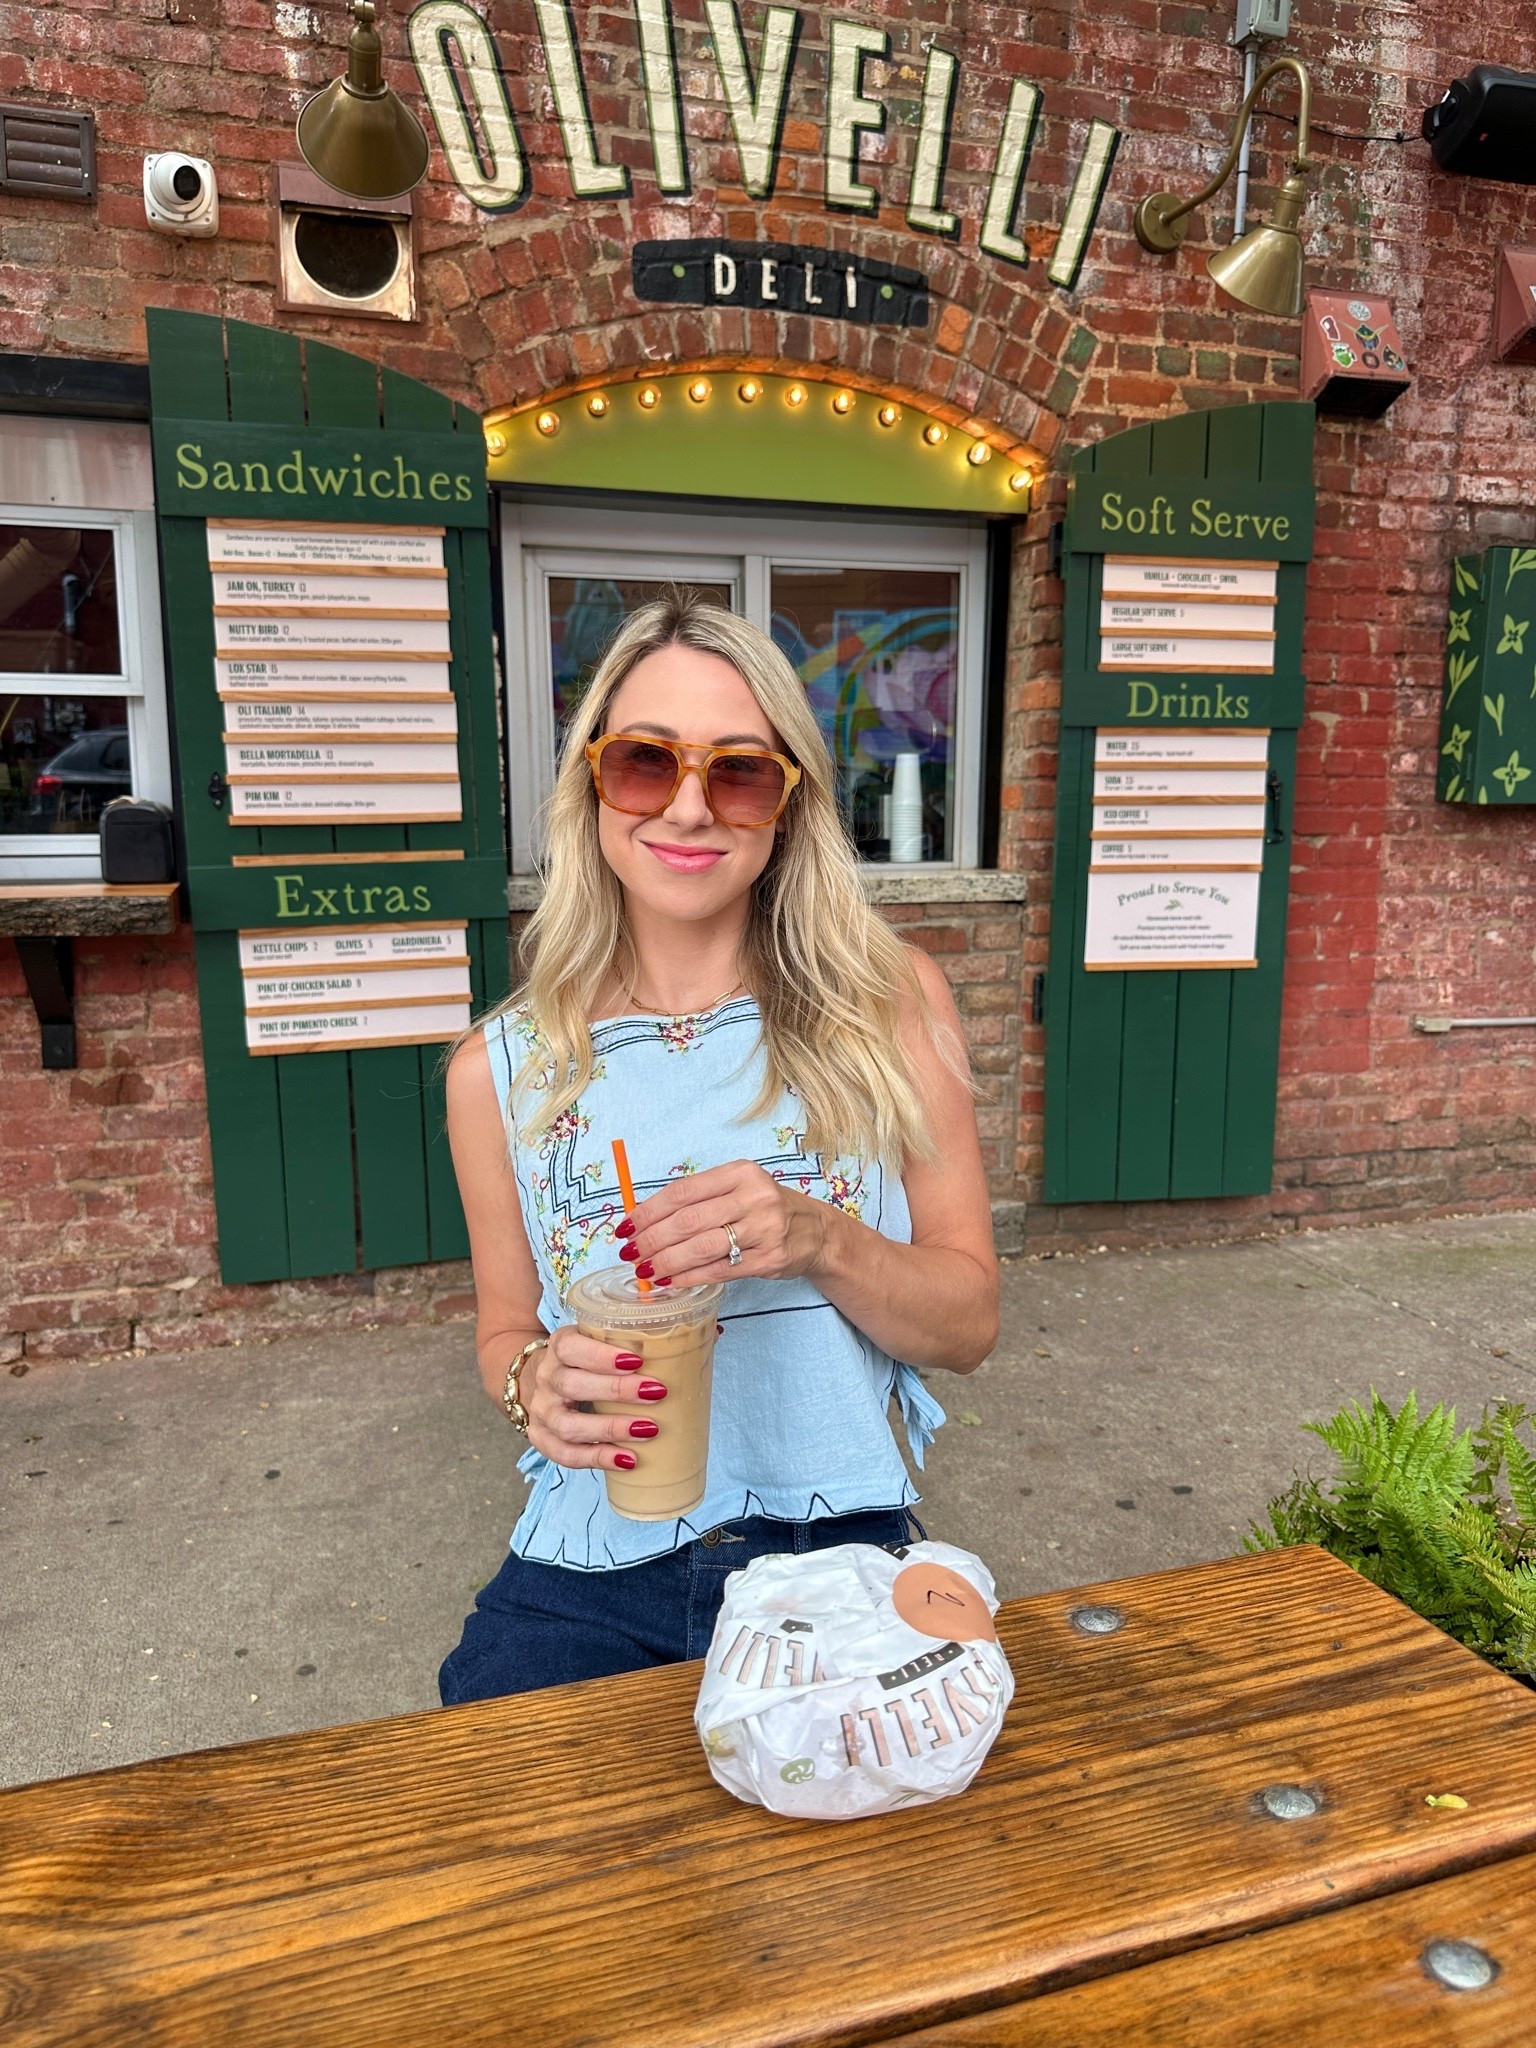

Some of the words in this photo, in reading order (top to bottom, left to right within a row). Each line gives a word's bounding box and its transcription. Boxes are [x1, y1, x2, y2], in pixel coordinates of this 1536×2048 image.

[407, 0, 1121, 286] OLIVELLI
[714, 252, 858, 308] DELI
[176, 443, 473, 501] Sandwiches
[1101, 492, 1177, 535] Soft
[1190, 498, 1291, 541] Serve
[1143, 571, 1169, 581] VANILLA
[1176, 573, 1212, 583] CHOCOLATE
[227, 581, 244, 591] JAM
[262, 581, 295, 592] TURKEY
[1112, 607, 1140, 616] REGULAR
[1141, 608, 1156, 617] SOFT
[1157, 608, 1176, 617] SERVE
[228, 624, 256, 635] NUTTY
[258, 625, 279, 635] BIRD
[1112, 642, 1132, 652] LARGE
[1133, 643, 1148, 652] SOFT
[1150, 643, 1168, 652] SERVE
[228, 663, 244, 673] LOX
[246, 664, 267, 673] STAR
[1127, 681, 1249, 719] Drinks
[238, 705, 251, 715] OLI
[254, 705, 292, 716] ITALIANO
[1106, 742, 1127, 751] WATER
[240, 750, 265, 760] BELLA
[267, 750, 321, 760] MORTADELLA
[245, 791, 261, 801] PIM
[263, 791, 280, 801] KIM
[1118, 810, 1141, 819] COFFEE
[1101, 845, 1124, 853] COFFEE
[274, 874, 432, 918] Extras
[1117, 883, 1155, 907] Proud
[1158, 883, 1169, 894] to
[1172, 881, 1207, 896] Serve
[1208, 886, 1231, 906] You
[335, 939, 363, 950] OLIVES
[391, 935, 442, 947] GIARDINIERA
[253, 942, 284, 954] KETTLE
[284, 941, 308, 952] CHIPS
[258, 983, 277, 993] PINT
[279, 982, 288, 992] OF
[291, 981, 325, 992] CHICKEN
[326, 979, 352, 990] SALAD
[259, 1022, 279, 1032] PINT
[280, 1021, 290, 1031] OF
[292, 1019, 329, 1030] PIMENTO
[330, 1017, 358, 1028] CHEESE
[900, 1653, 945, 1679] DELI
